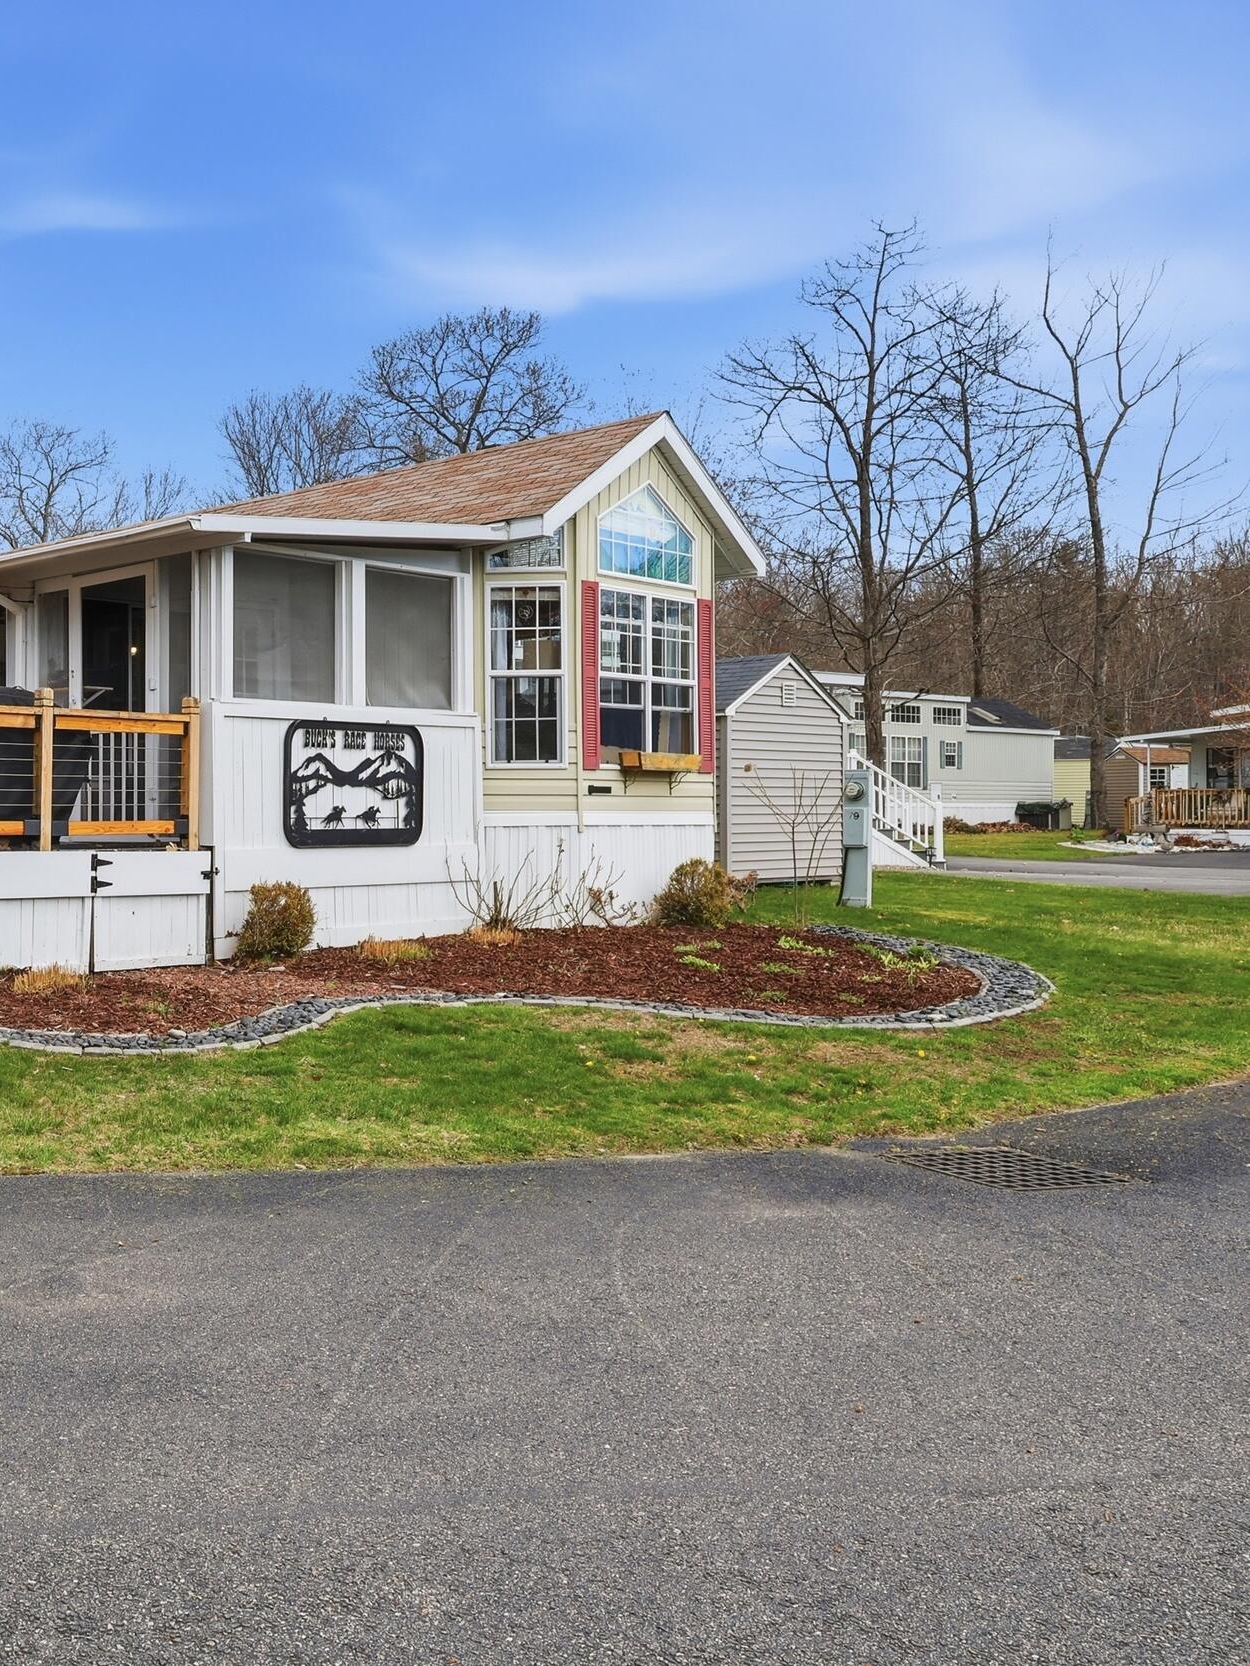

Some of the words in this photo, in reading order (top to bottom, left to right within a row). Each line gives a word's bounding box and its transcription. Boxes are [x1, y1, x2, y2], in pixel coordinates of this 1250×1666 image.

[304, 728, 336, 749] BUCK'S
[343, 730, 367, 750] RACE
[373, 732, 406, 752] HORSES
